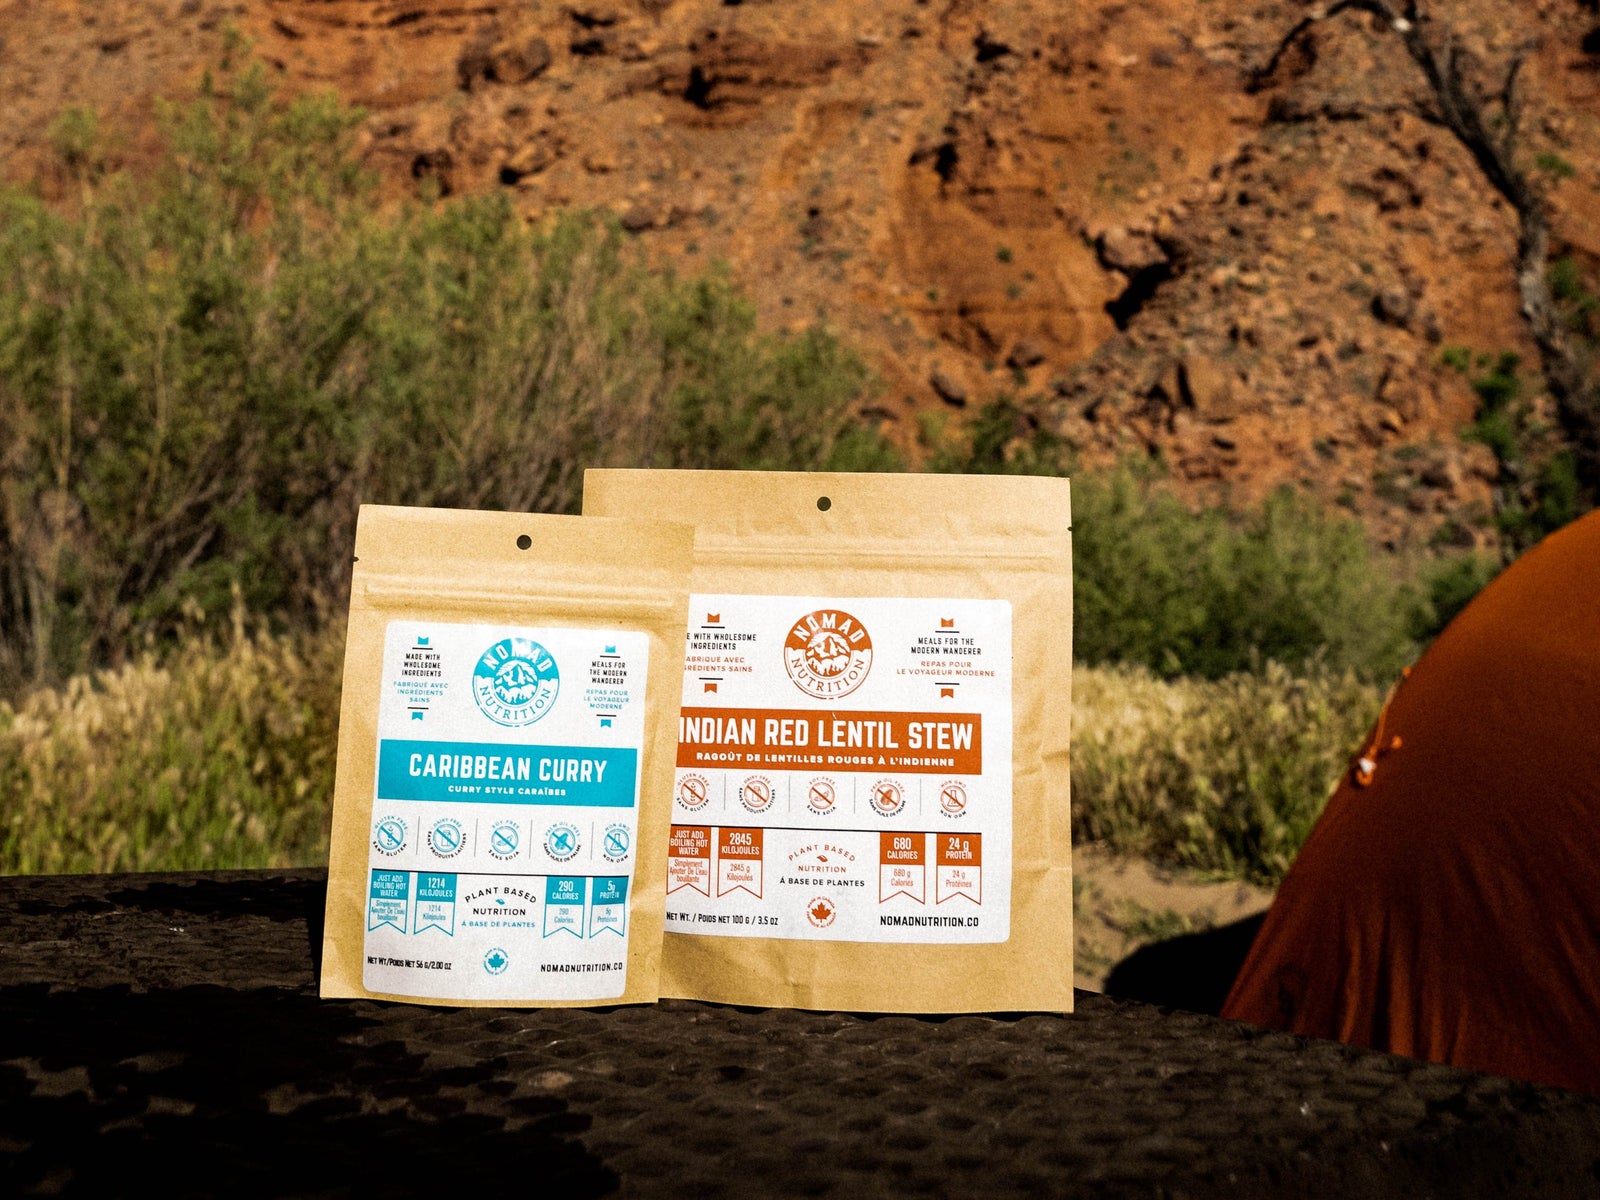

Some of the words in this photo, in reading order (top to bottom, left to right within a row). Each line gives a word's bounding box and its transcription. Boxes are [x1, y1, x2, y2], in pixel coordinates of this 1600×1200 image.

[793, 613, 865, 643] NOMAD
[714, 633, 757, 641] WHOLESOME
[918, 637, 942, 645] MEALS
[945, 637, 958, 645] FOR
[961, 638, 974, 646] THE
[691, 642, 736, 650] INGREDIENTS
[911, 646, 940, 654] MODERN
[943, 647, 982, 655] WANDERER
[425, 653, 440, 661] WITH
[403, 661, 441, 669] WHOLESOME
[614, 661, 626, 669] FOR
[728, 665, 753, 673] SAINS
[401, 669, 442, 678] INGREDIENTS
[792, 658, 864, 692] NUTRITION
[908, 668, 953, 676] VOYAGEUR
[955, 669, 995, 677] MODERNE
[480, 686, 551, 720] NUTRITION
[679, 716, 756, 745] INDIAN
[764, 718, 809, 746] RED
[817, 719, 899, 749] LENTIL
[908, 721, 973, 750] STEW
[696, 752, 742, 762] RAGOÛT
[746, 753, 761, 762] DE
[765, 753, 823, 763] LENTILLES
[827, 756, 874, 765] ROUGES
[878, 755, 886, 765] À
[890, 756, 954, 767] L'INDIENNE
[409, 752, 531, 781] CARIBBEAN
[538, 757, 608, 783] CURRY
[448, 784, 482, 794] CURRY
[484, 786, 515, 795] STYLE
[518, 786, 567, 796] CARAÏBES
[676, 797, 688, 810] SANS
[690, 799, 710, 812] GLUTEN
[806, 804, 820, 815] SANS
[822, 806, 837, 816] SOJA
[675, 830, 690, 838] JUST
[691, 831, 704, 839] ADD
[729, 832, 752, 846] 2845
[670, 838, 695, 847] BOILING
[696, 839, 708, 848] HOT
[893, 837, 912, 850] 680
[949, 837, 961, 850] 24
[963, 840, 969, 852] g
[373, 840, 384, 855] SANS
[386, 843, 407, 857] GLUTEN
[678, 847, 699, 855] WATER
[721, 845, 760, 855] KILOJOULES
[788, 844, 819, 861] PLANT
[824, 844, 856, 862] BASED
[488, 849, 503, 861] SANS
[505, 850, 520, 861] SOJA
[887, 850, 918, 859] CALORIES
[945, 850, 972, 859] PROTEIN
[730, 863, 744, 871] 2845
[746, 866, 751, 874] g
[798, 865, 847, 873] NUTRITION
[727, 873, 753, 882] Kilojoules
[893, 869, 905, 877] 680
[907, 870, 911, 878] g
[952, 870, 960, 878] 24
[961, 871, 966, 879] g
[377, 874, 391, 882] JUST
[391, 875, 404, 883] ADD
[427, 877, 446, 889] 1214
[788, 877, 810, 885] BASE
[812, 878, 824, 886] DE
[826, 879, 865, 887] PLANTES
[891, 878, 914, 887] Calories
[373, 881, 395, 889] BOILING
[395, 882, 407, 890] HOT
[558, 880, 574, 892] 290
[607, 880, 616, 893] 5g
[380, 889, 399, 897] WATER
[419, 888, 453, 898] KILOJOULES
[464, 886, 499, 903] PLANT
[503, 886, 537, 903] BASED
[551, 891, 579, 900] CALORIES
[599, 891, 619, 899] PROTEIN
[428, 904, 441, 912] 1214
[472, 907, 526, 916] NUTRITION
[717, 915, 730, 924] NET
[732, 915, 743, 924] 100
[758, 916, 768, 925] 3.5
[770, 917, 778, 925] OZ
[880, 915, 979, 927] NOMADNUTRITION.CO
[416, 960, 423, 968] 56
[540, 962, 623, 973] NOMADNUTRITION.CO
